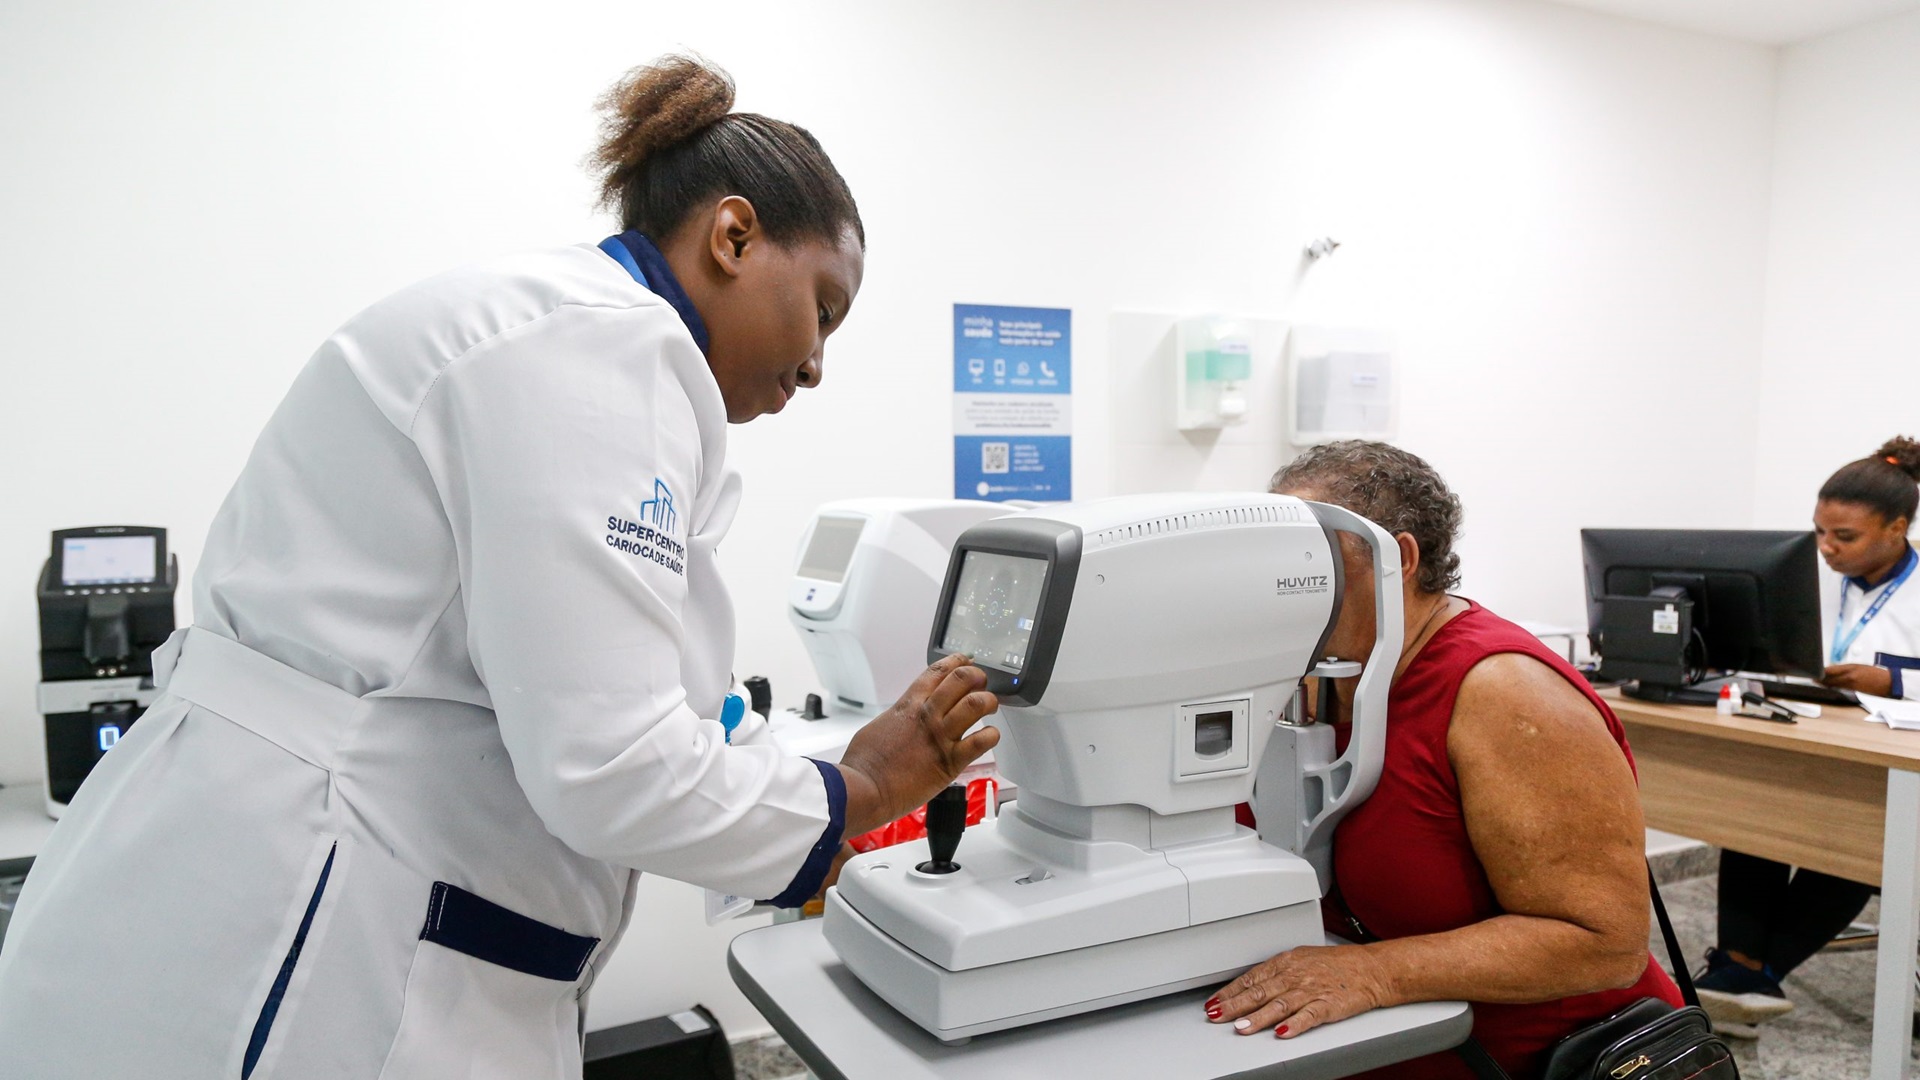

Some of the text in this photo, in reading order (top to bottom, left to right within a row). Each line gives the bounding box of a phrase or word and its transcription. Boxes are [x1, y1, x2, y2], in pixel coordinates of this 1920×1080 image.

[606, 534, 684, 576] CARIOCA DE SAÚDE
[607, 516, 685, 560] SUPER CENTRO
[1277, 576, 1328, 588] HUVITZ
